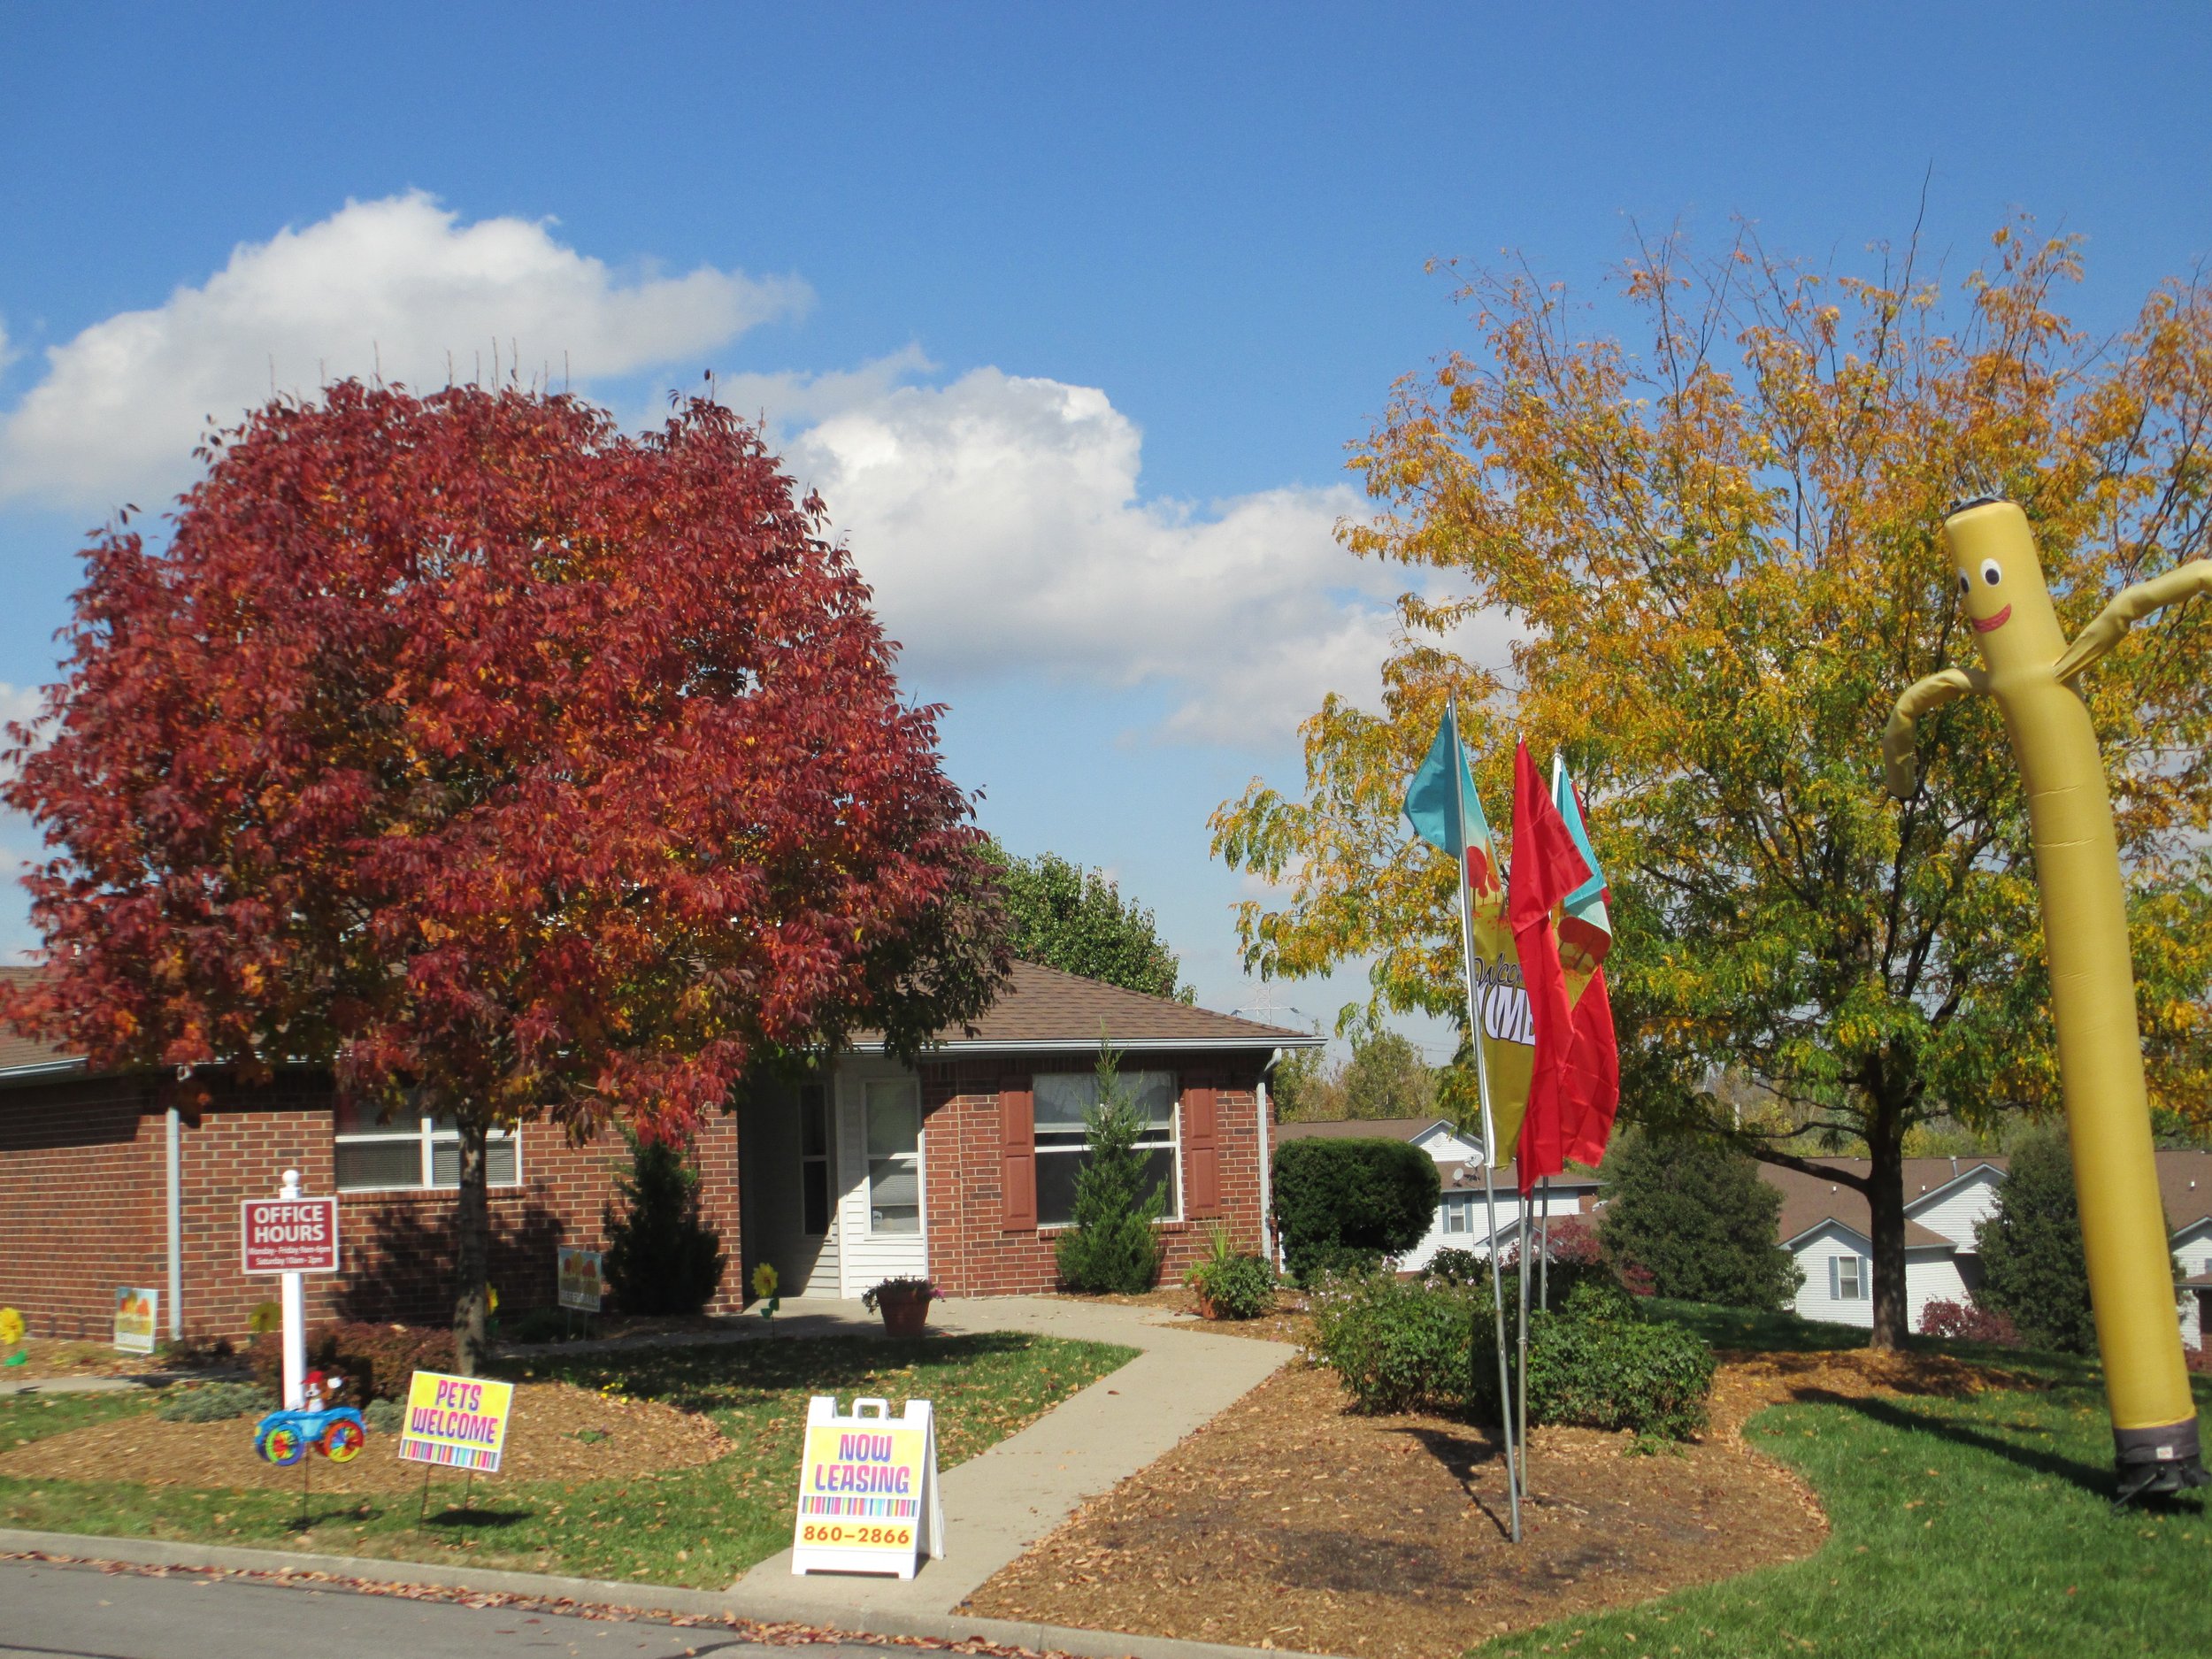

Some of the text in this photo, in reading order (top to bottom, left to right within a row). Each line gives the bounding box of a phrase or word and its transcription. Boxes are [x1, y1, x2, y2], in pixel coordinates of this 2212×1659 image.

[254, 1205, 325, 1224] OFFICE
[254, 1225, 326, 1243] HOURS
[435, 1379, 482, 1411] PETS
[411, 1406, 498, 1444] WELCOME
[839, 1433, 893, 1463] NOW
[815, 1463, 910, 1494] LEASING
[803, 1525, 910, 1544] 860-2866
